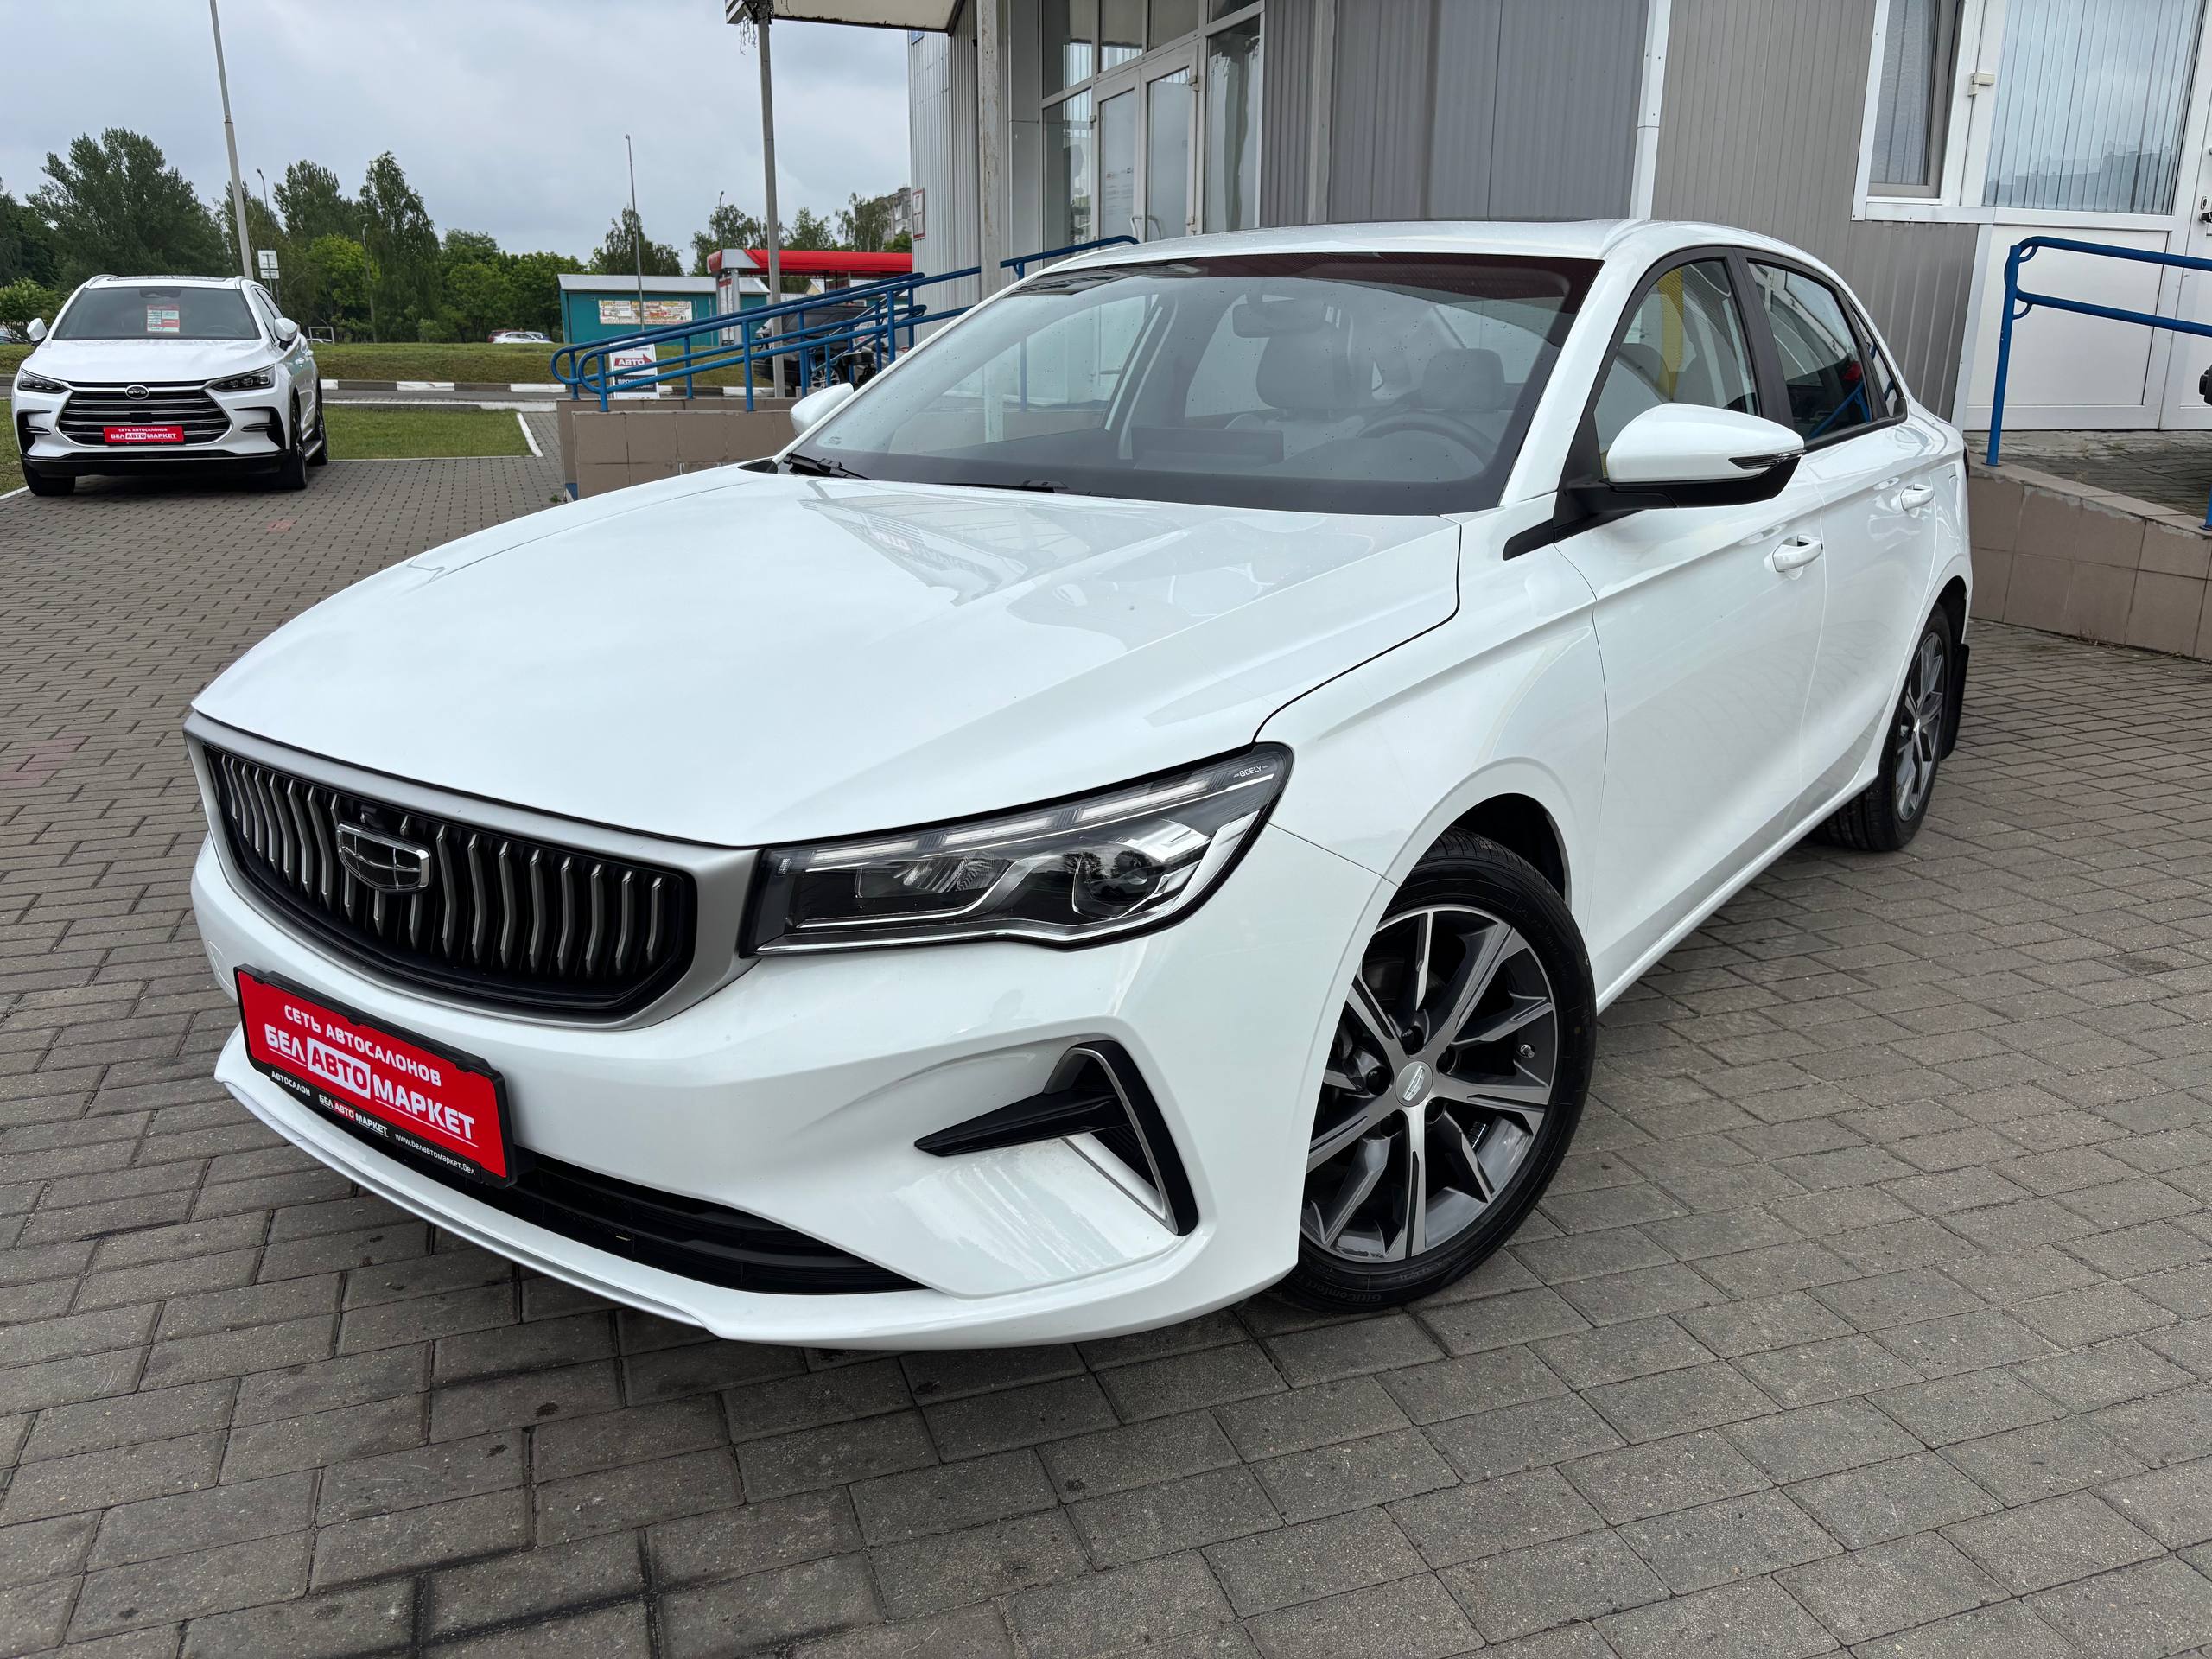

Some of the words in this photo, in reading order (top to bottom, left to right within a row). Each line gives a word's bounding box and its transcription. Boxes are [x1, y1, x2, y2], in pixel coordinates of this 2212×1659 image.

[1239, 766, 1262, 777] GEELY
[264, 1023, 306, 1063] БЕЛ
[309, 1040, 370, 1094] АВТО
[372, 1074, 474, 1140] МАРКЕТ
[283, 1004, 321, 1033] СЕТЬ
[326, 1026, 442, 1087] АВТОСАЛОНОВ
[271, 1071, 311, 1096] АВТОСАЛОН
[318, 1094, 334, 1109] БЕЛ
[334, 1103, 355, 1118] АВТО
[355, 1112, 388, 1135] МАРКЕТ
[394, 1133, 476, 1176] www.белавтомаркет.бел
[1306, 1277, 1382, 1302] GitiComfort
